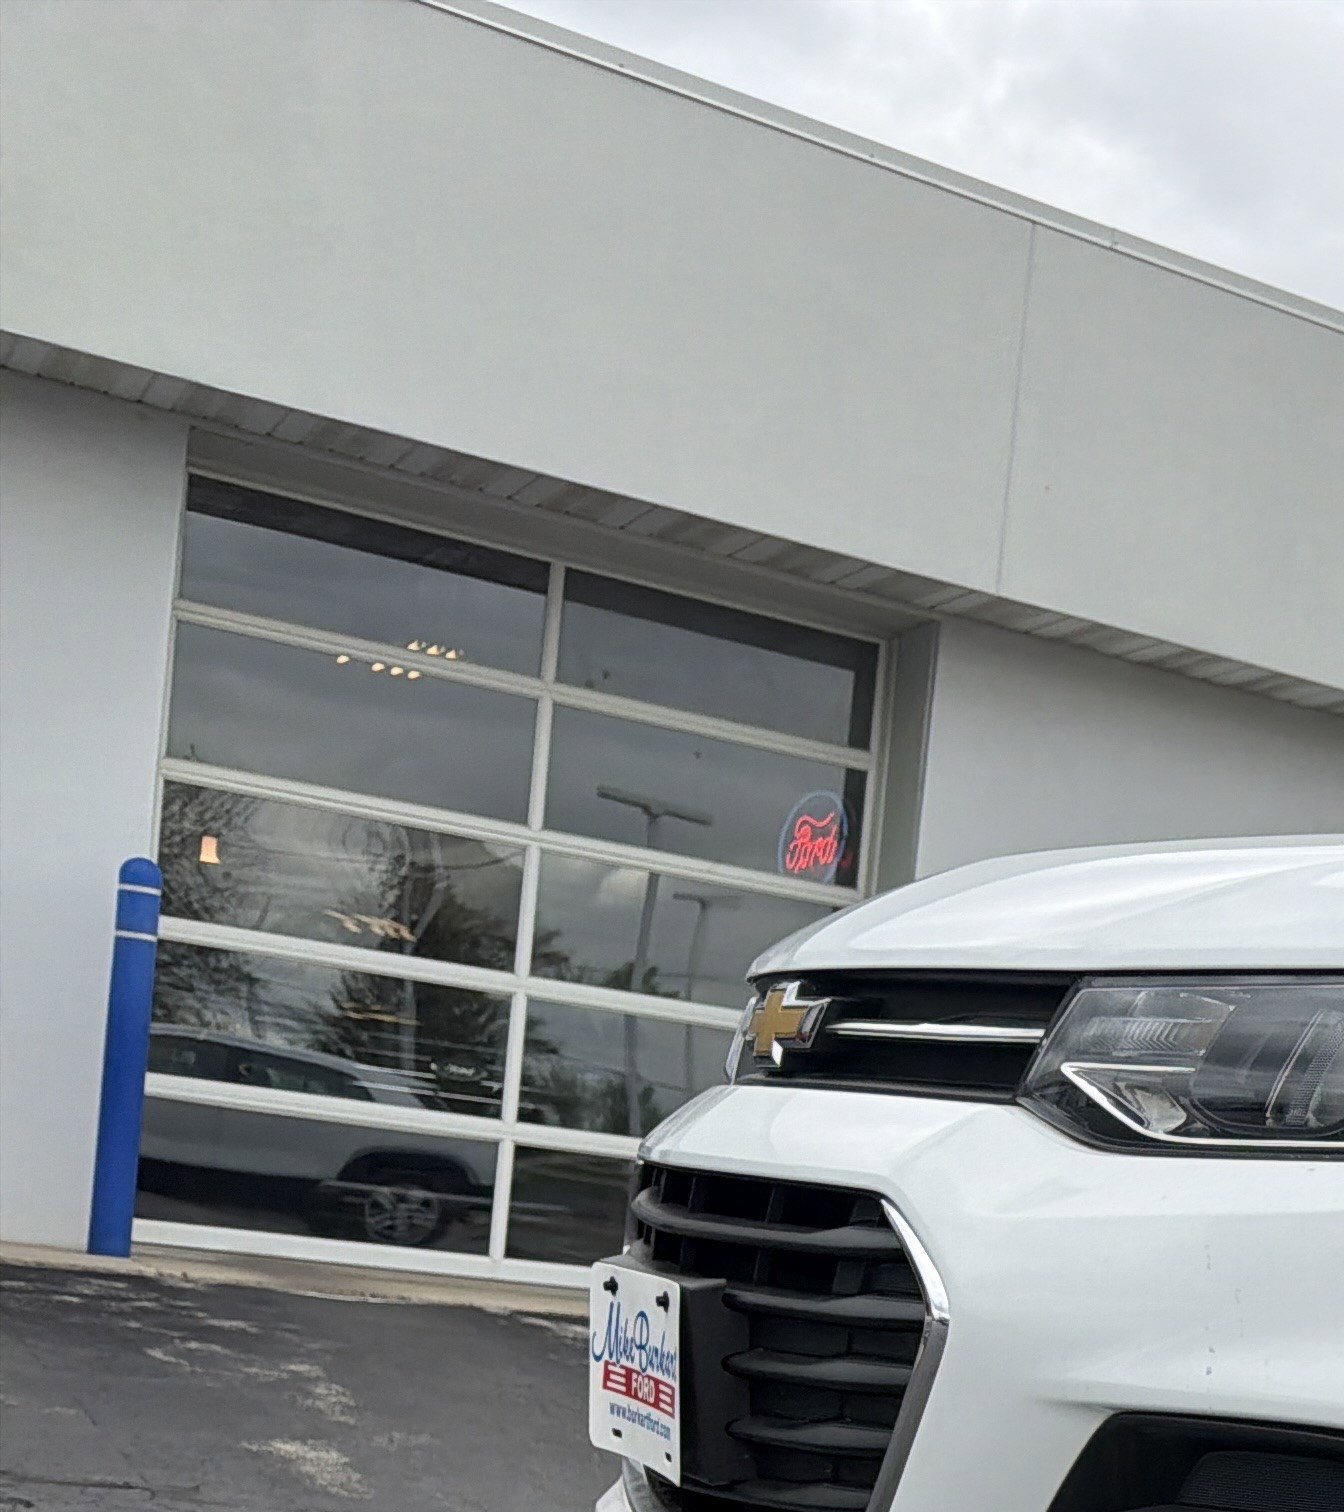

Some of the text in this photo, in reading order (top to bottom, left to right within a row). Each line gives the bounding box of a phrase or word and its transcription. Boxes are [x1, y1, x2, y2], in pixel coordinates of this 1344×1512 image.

[785, 811, 838, 875] Ford
[591, 1301, 635, 1364] Mike
[630, 1372, 656, 1404] FORD
